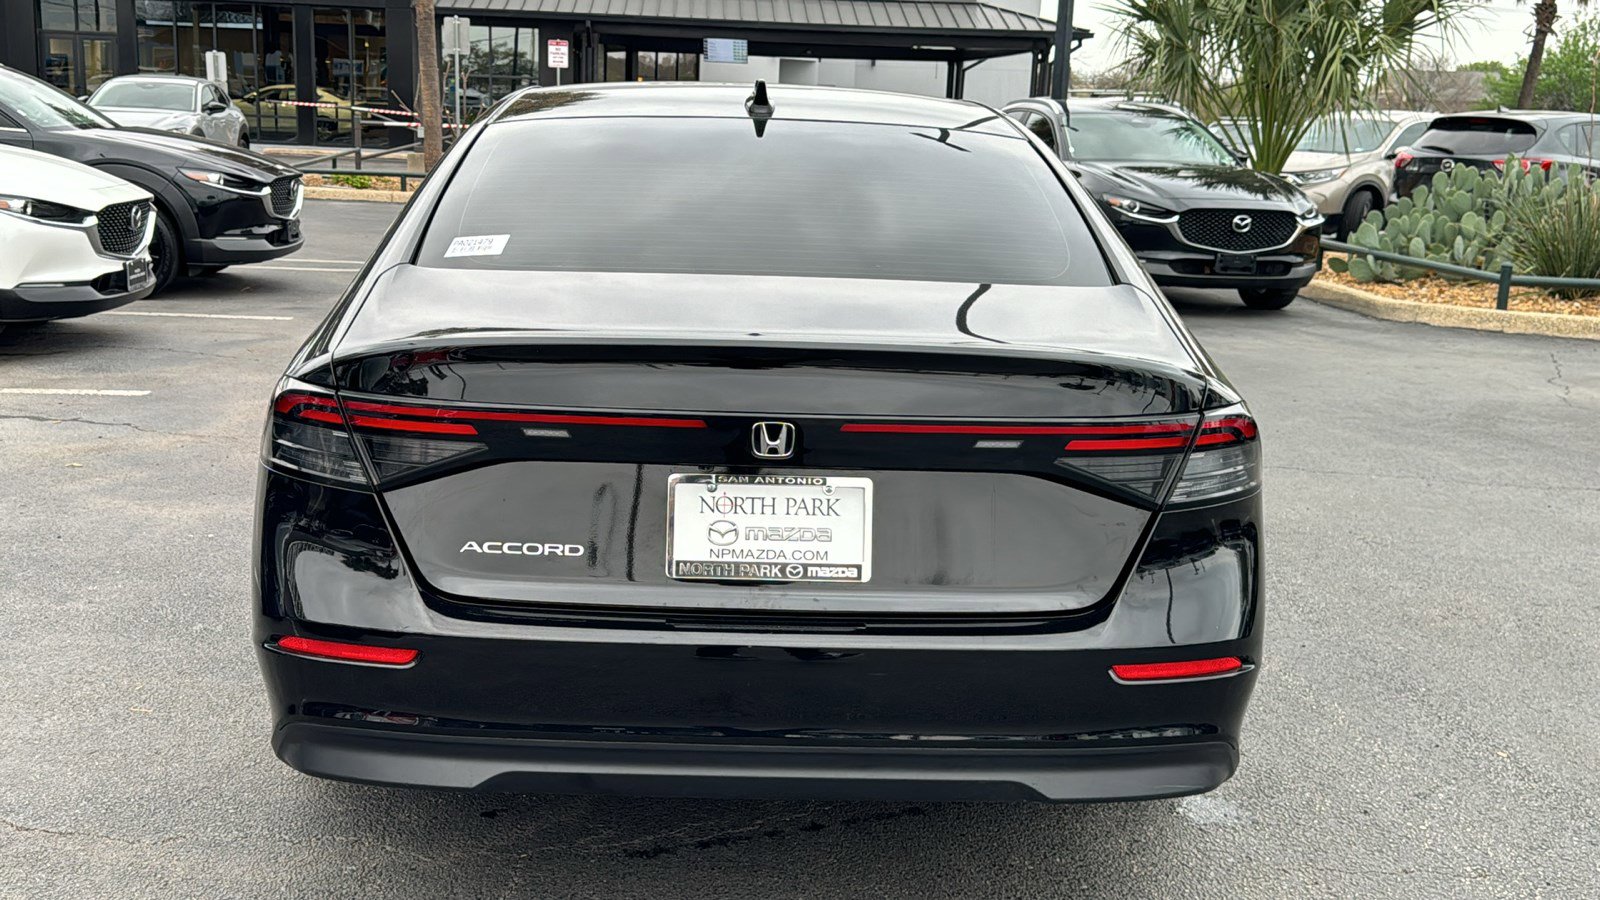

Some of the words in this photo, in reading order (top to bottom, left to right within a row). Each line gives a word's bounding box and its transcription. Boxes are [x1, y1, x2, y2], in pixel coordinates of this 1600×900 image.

[717, 475, 749, 484] SAN
[753, 477, 824, 486] ANTONIO
[699, 495, 776, 516] NORTH
[785, 497, 841, 517] PARK
[744, 526, 833, 543] mazda
[459, 541, 585, 557] ACCORD
[709, 548, 829, 561] NPMAZDA.COM
[678, 560, 735, 577] NORTH
[738, 564, 782, 578] PARK
[807, 566, 858, 578] mazda
